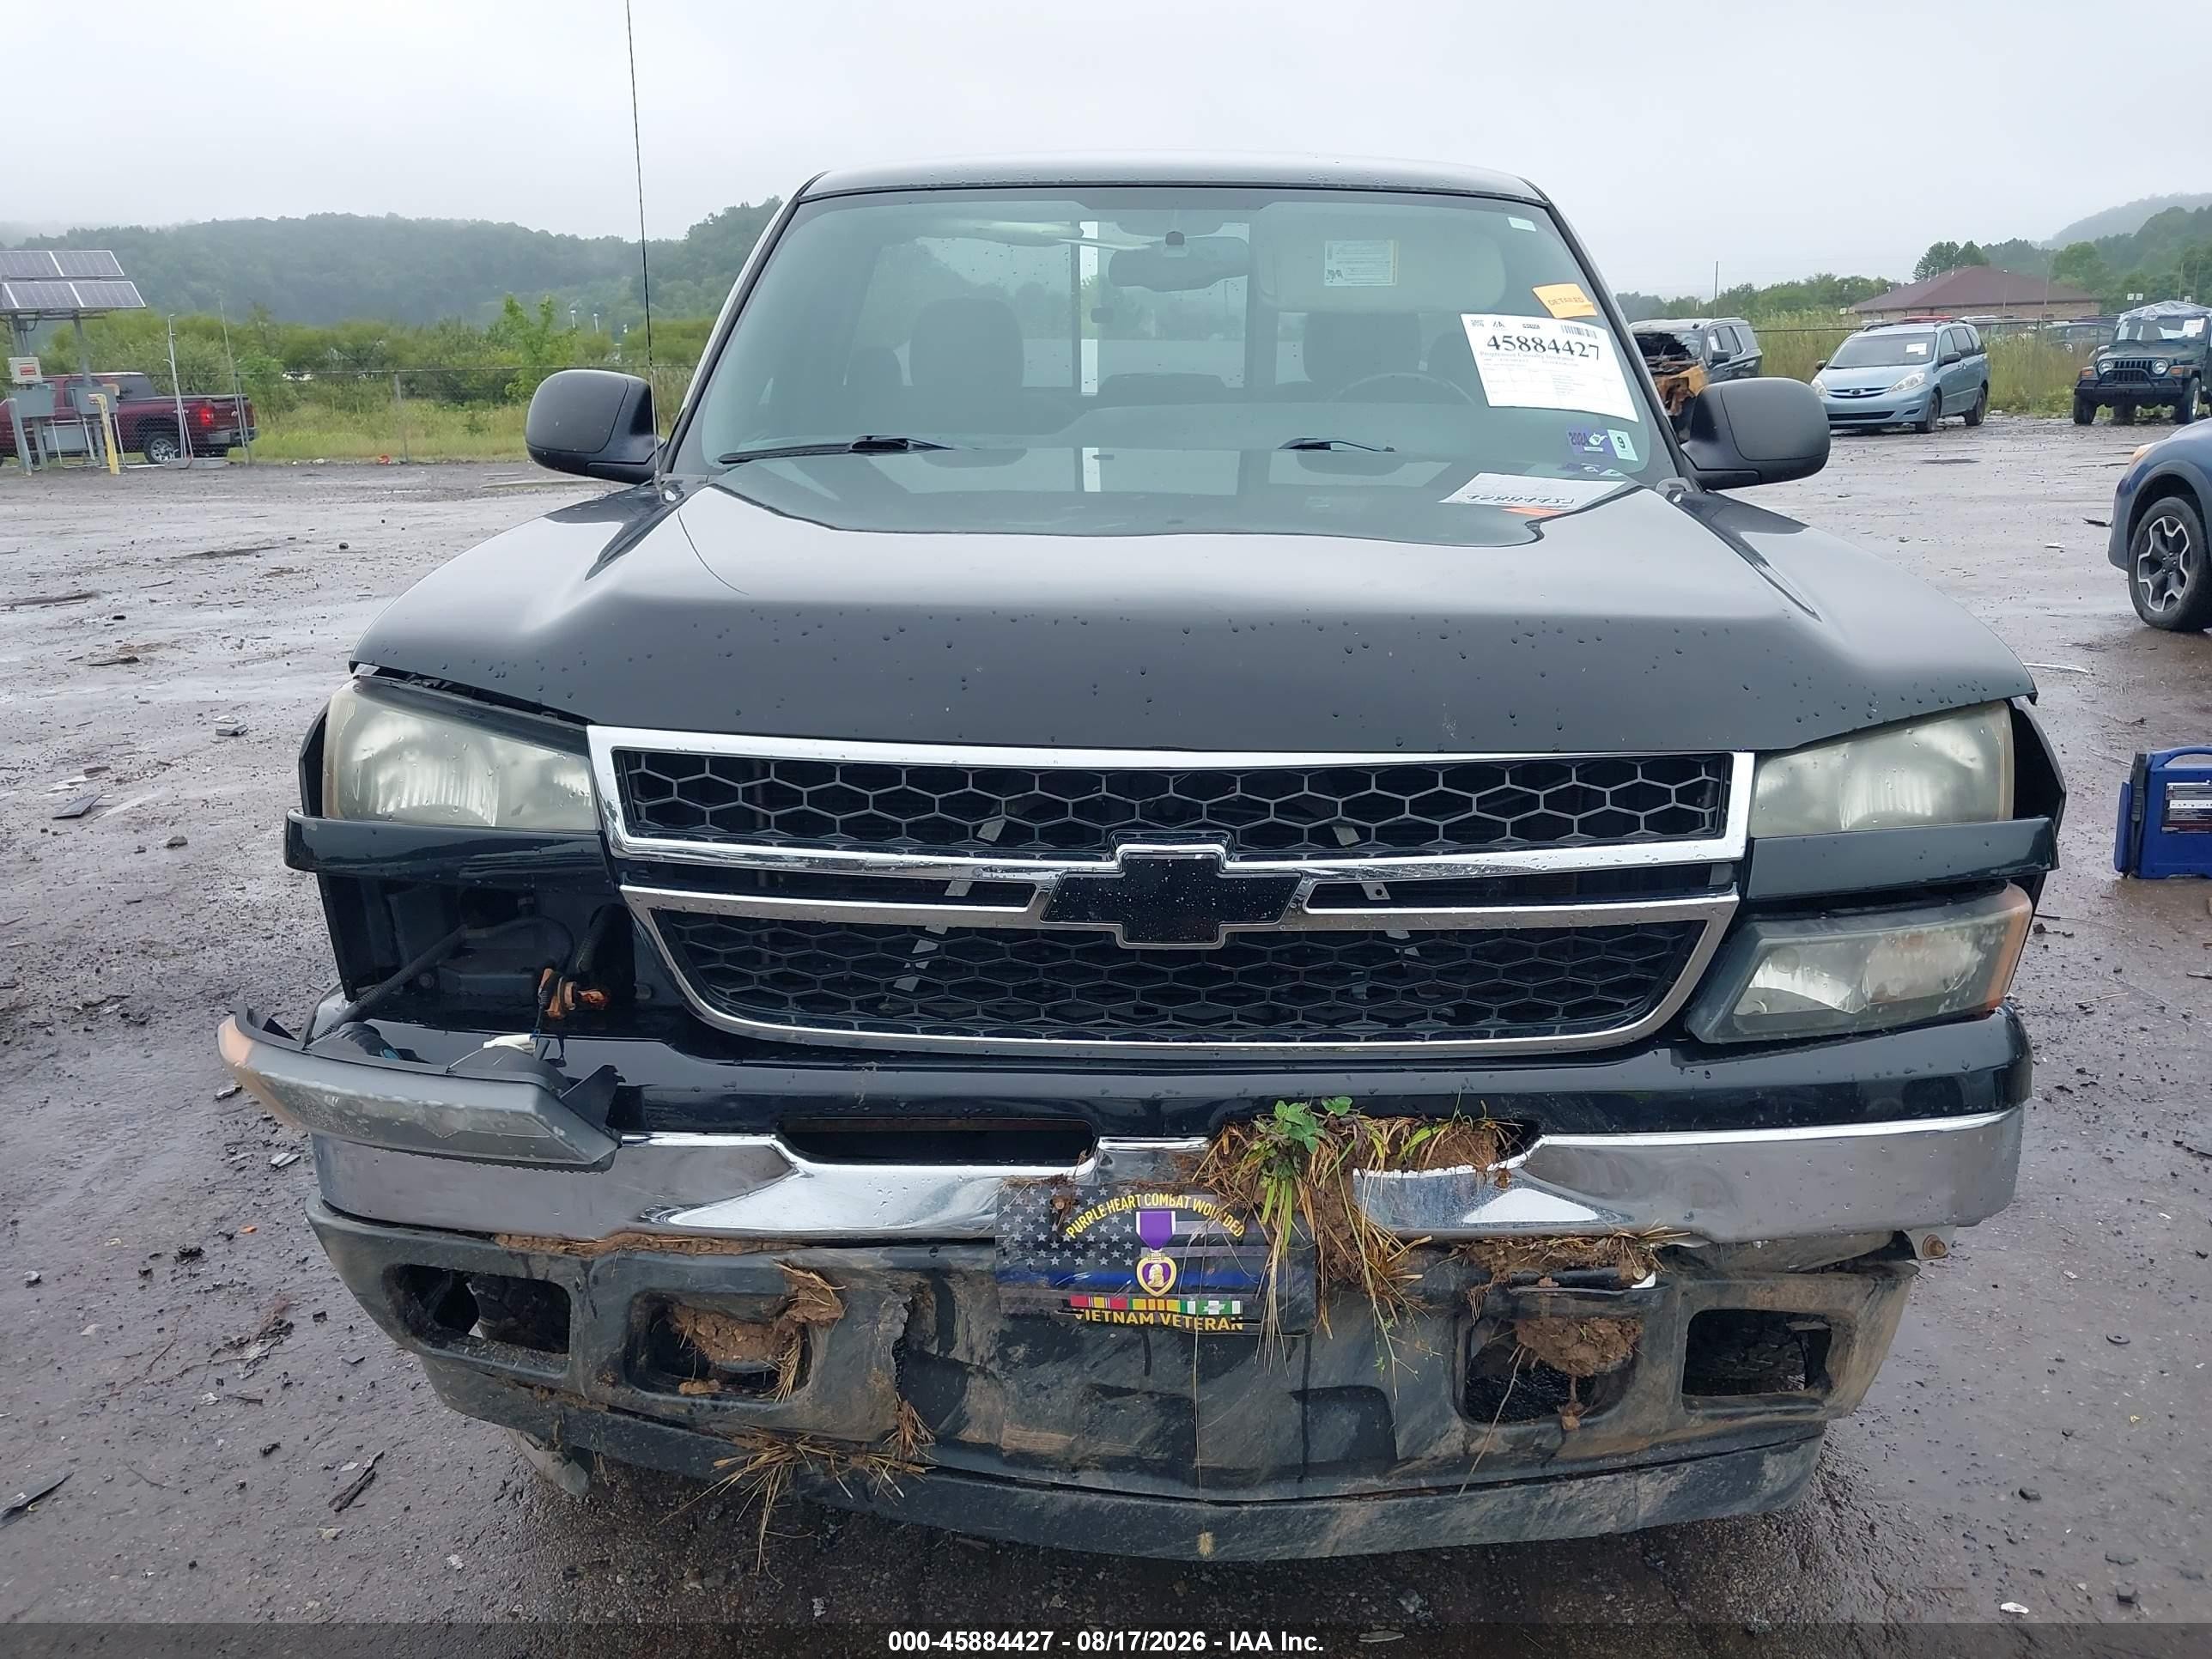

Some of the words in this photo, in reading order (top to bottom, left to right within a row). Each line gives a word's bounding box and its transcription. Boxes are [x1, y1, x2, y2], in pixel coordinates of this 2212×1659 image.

[1486, 334, 1600, 361] 45884427
[1066, 1204, 1107, 1238] PURPLE
[1106, 1194, 1142, 1214] HEART
[1193, 1198, 1245, 1237] WOUDED
[1159, 1313, 1244, 1331] VETERAN
